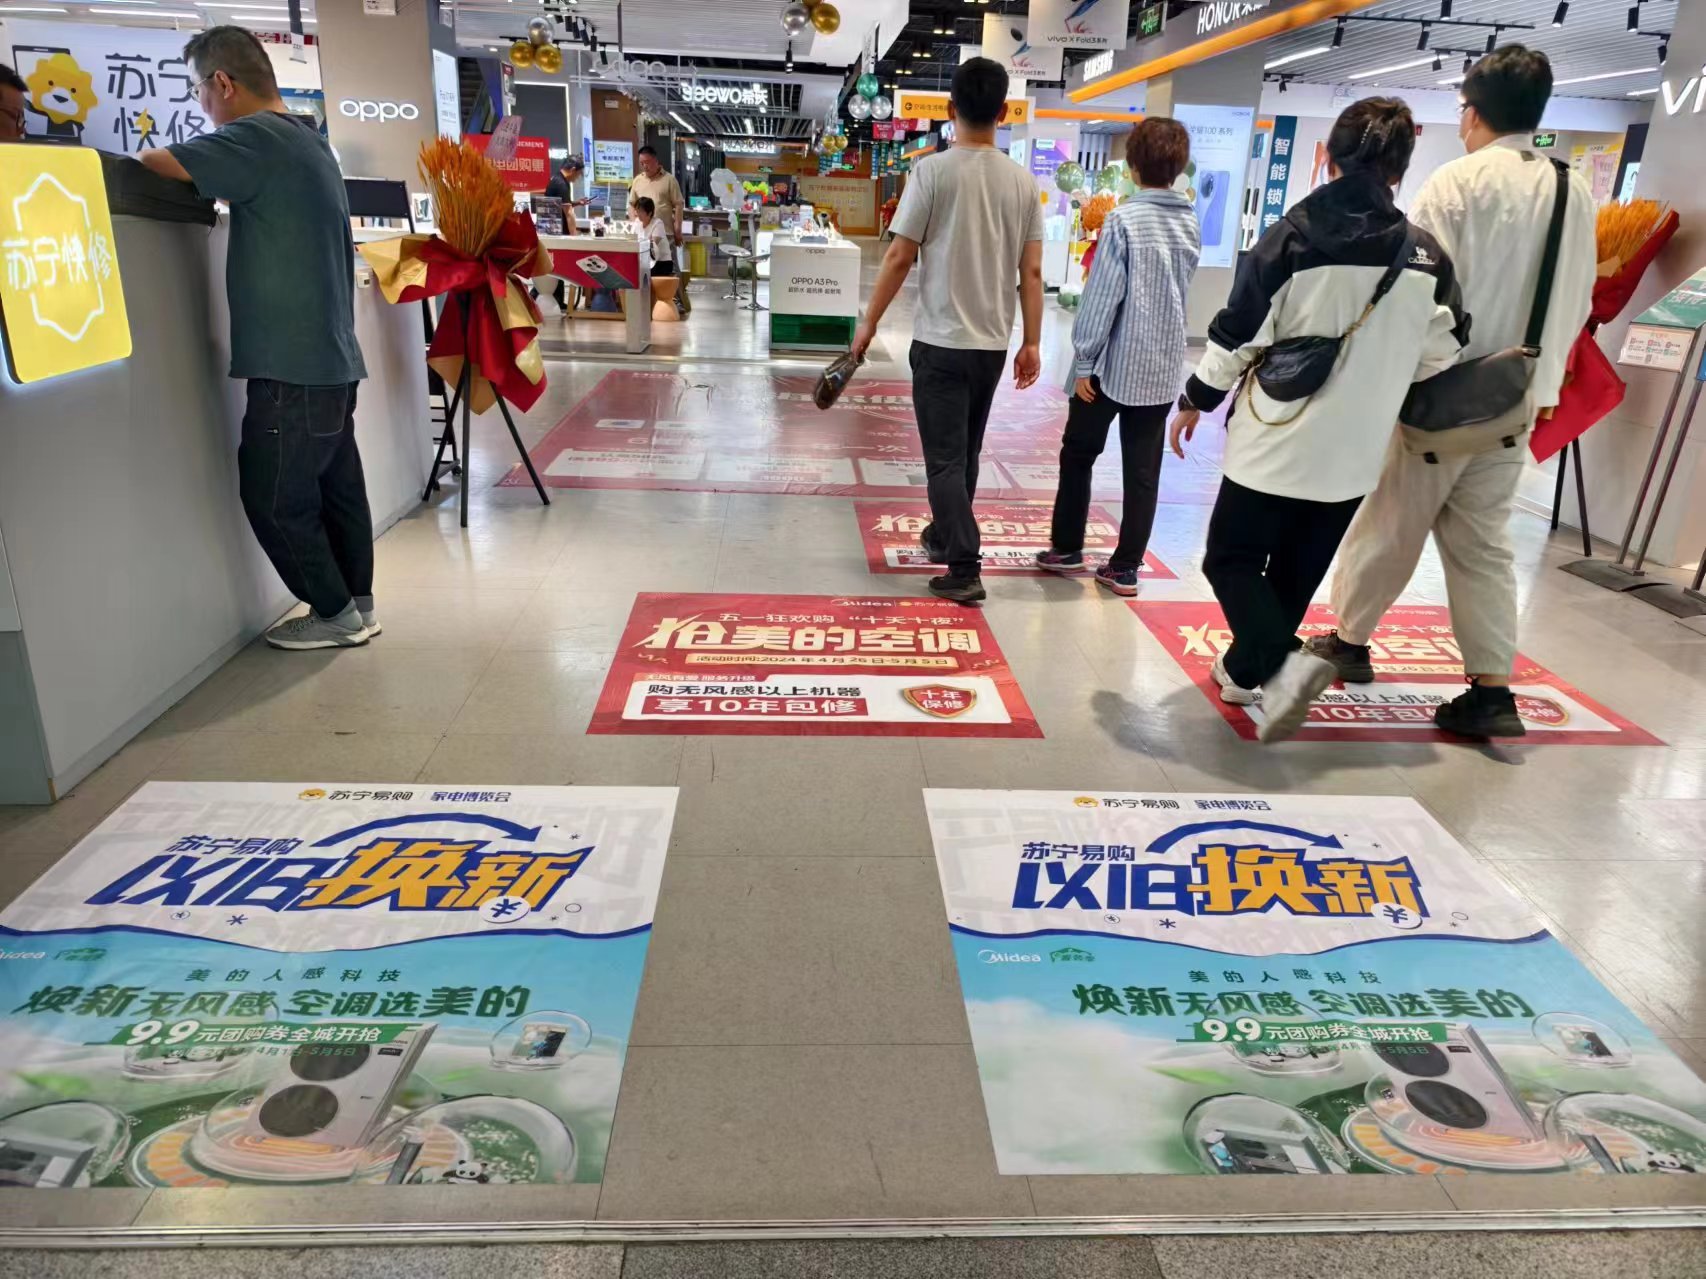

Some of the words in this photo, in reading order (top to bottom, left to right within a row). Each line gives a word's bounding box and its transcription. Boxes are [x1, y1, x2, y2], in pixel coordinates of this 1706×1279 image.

[1047, 35, 1068, 43] vivo
[105, 52, 193, 103] 苏宁
[517, 140, 545, 148] IEMENS
[3, 233, 112, 291] 苏宁快修
[791, 277, 814, 286] OPPO
[814, 277, 825, 286] A3
[825, 278, 839, 286] Pro
[718, 613, 835, 624] 五一狂欢购
[632, 612, 982, 654] 抢美的空调
[647, 684, 862, 697] 购无风感以上机器
[920, 689, 963, 700] 十年
[654, 698, 858, 715] 享10年包修
[922, 700, 966, 710] 保修
[329, 790, 414, 801] 苏宁易购
[430, 791, 512, 802] 家电博览会
[1102, 798, 1180, 810] 苏宁易购
[1194, 799, 1273, 811] 家电博览会
[165, 834, 305, 856] 苏宁易购
[1021, 841, 1136, 862] 苏宁易购
[84, 837, 595, 913] 以旧换新
[1011, 843, 1431, 918] 以旧换新
[982, 950, 1042, 964] Midea
[185, 966, 402, 982] 美的人感科技
[1187, 968, 1383, 985] 美的人感科技
[10, 982, 274, 1018] 焕新无风感
[282, 984, 531, 1018] 空调选美的
[1071, 983, 1302, 1017] 焕新无风感
[1309, 988, 1537, 1019] 空调选美的
